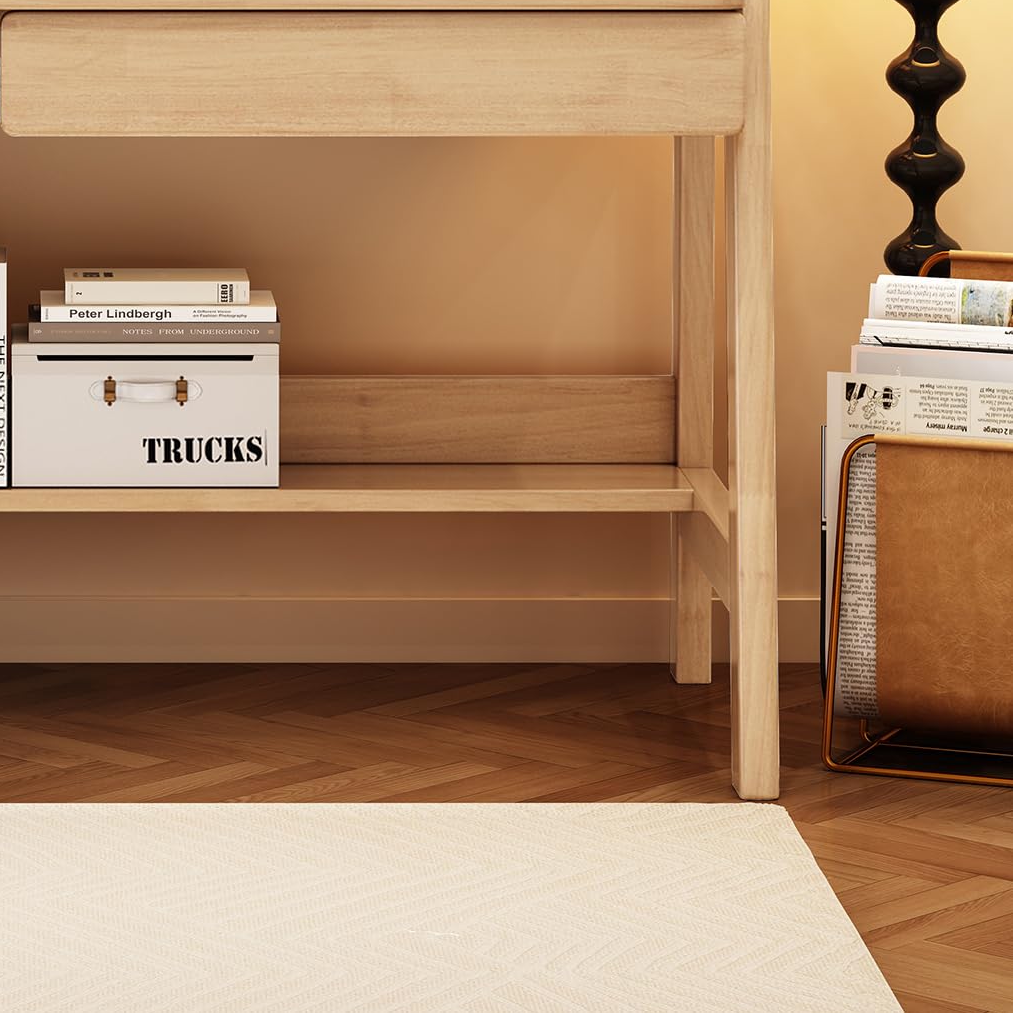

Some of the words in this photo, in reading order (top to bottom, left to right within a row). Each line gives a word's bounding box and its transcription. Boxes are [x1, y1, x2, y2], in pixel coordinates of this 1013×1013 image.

[220, 283, 229, 303] EERO
[69, 309, 105, 319] Peter
[107, 309, 172, 321] Lindbergh
[925, 421, 945, 431] misery
[946, 423, 968, 433] Murray
[143, 436, 263, 464] TRUCKS
